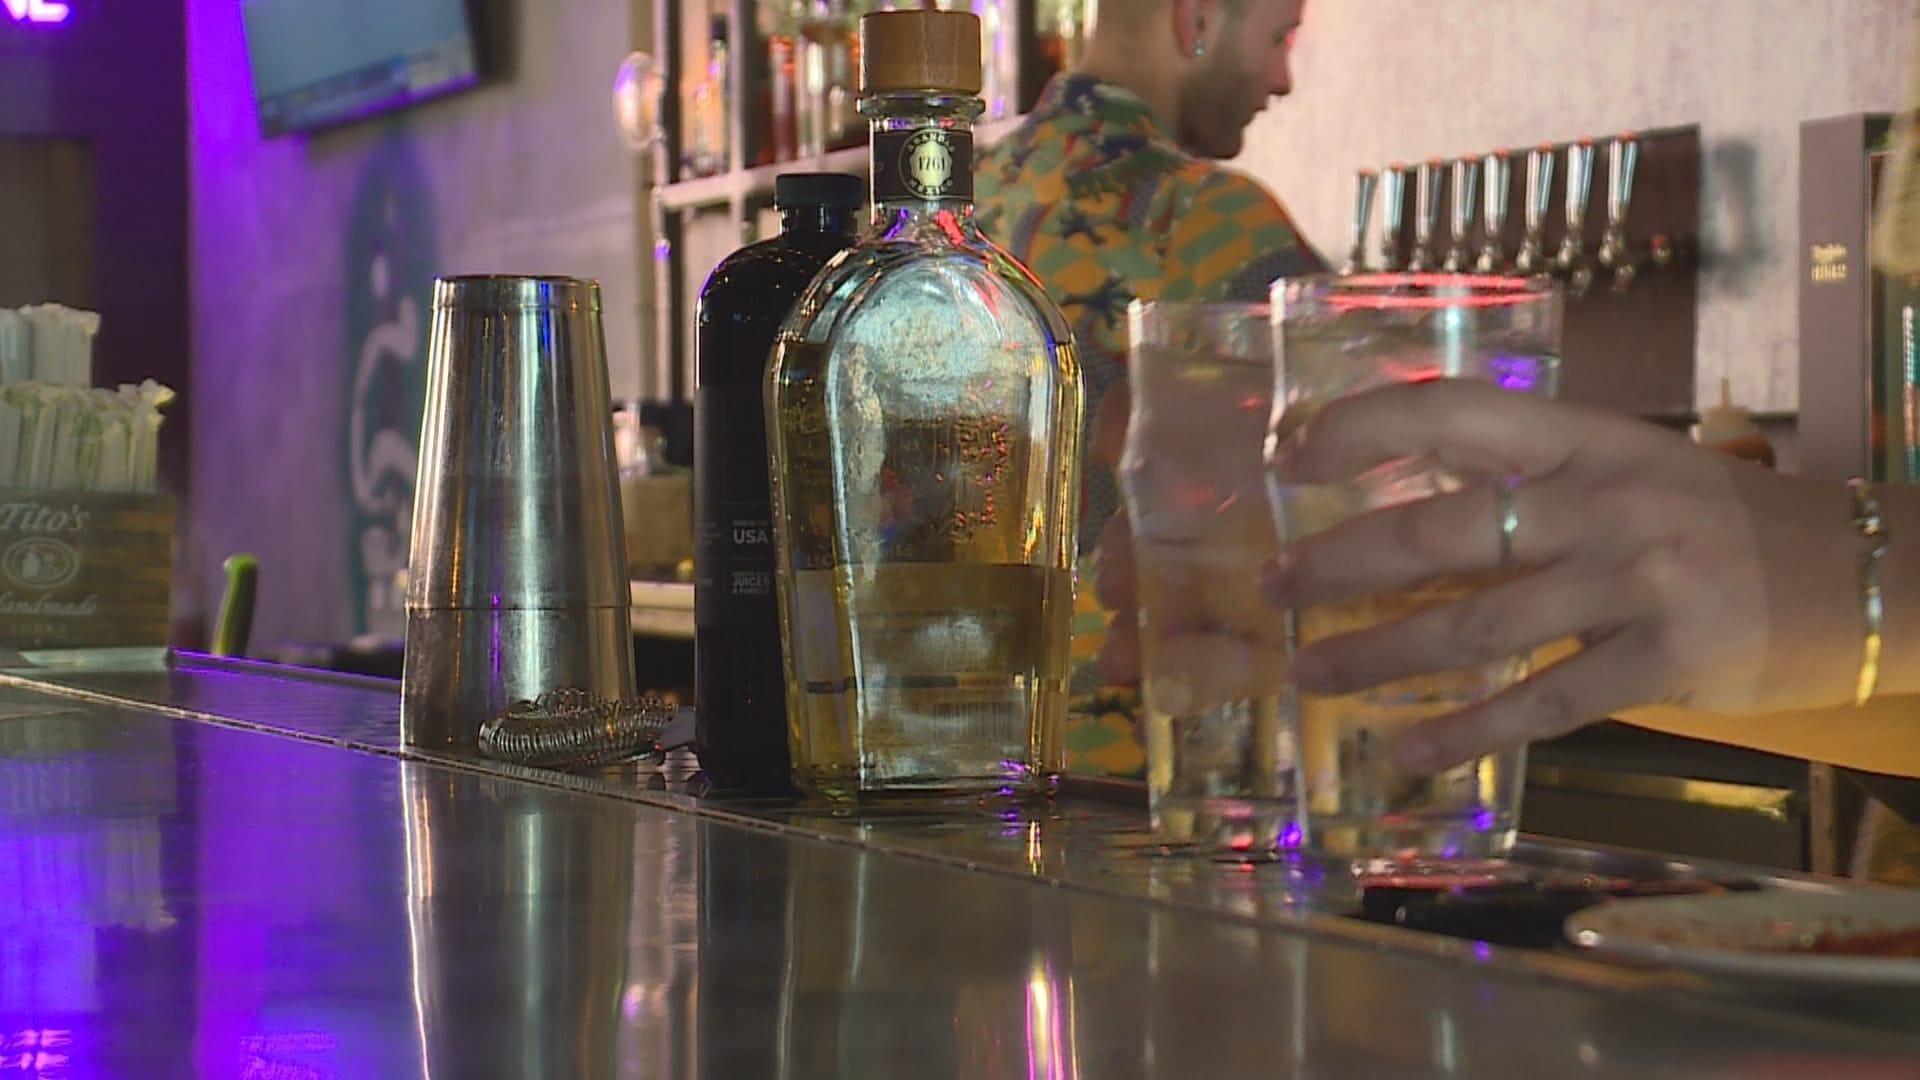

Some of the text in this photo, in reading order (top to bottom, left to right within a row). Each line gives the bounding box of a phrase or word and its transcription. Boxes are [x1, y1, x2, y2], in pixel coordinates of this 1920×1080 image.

[918, 156, 945, 171] 1761
[910, 177, 953, 195] MEXICO
[0, 503, 90, 533] Tito's
[733, 528, 768, 544] USA
